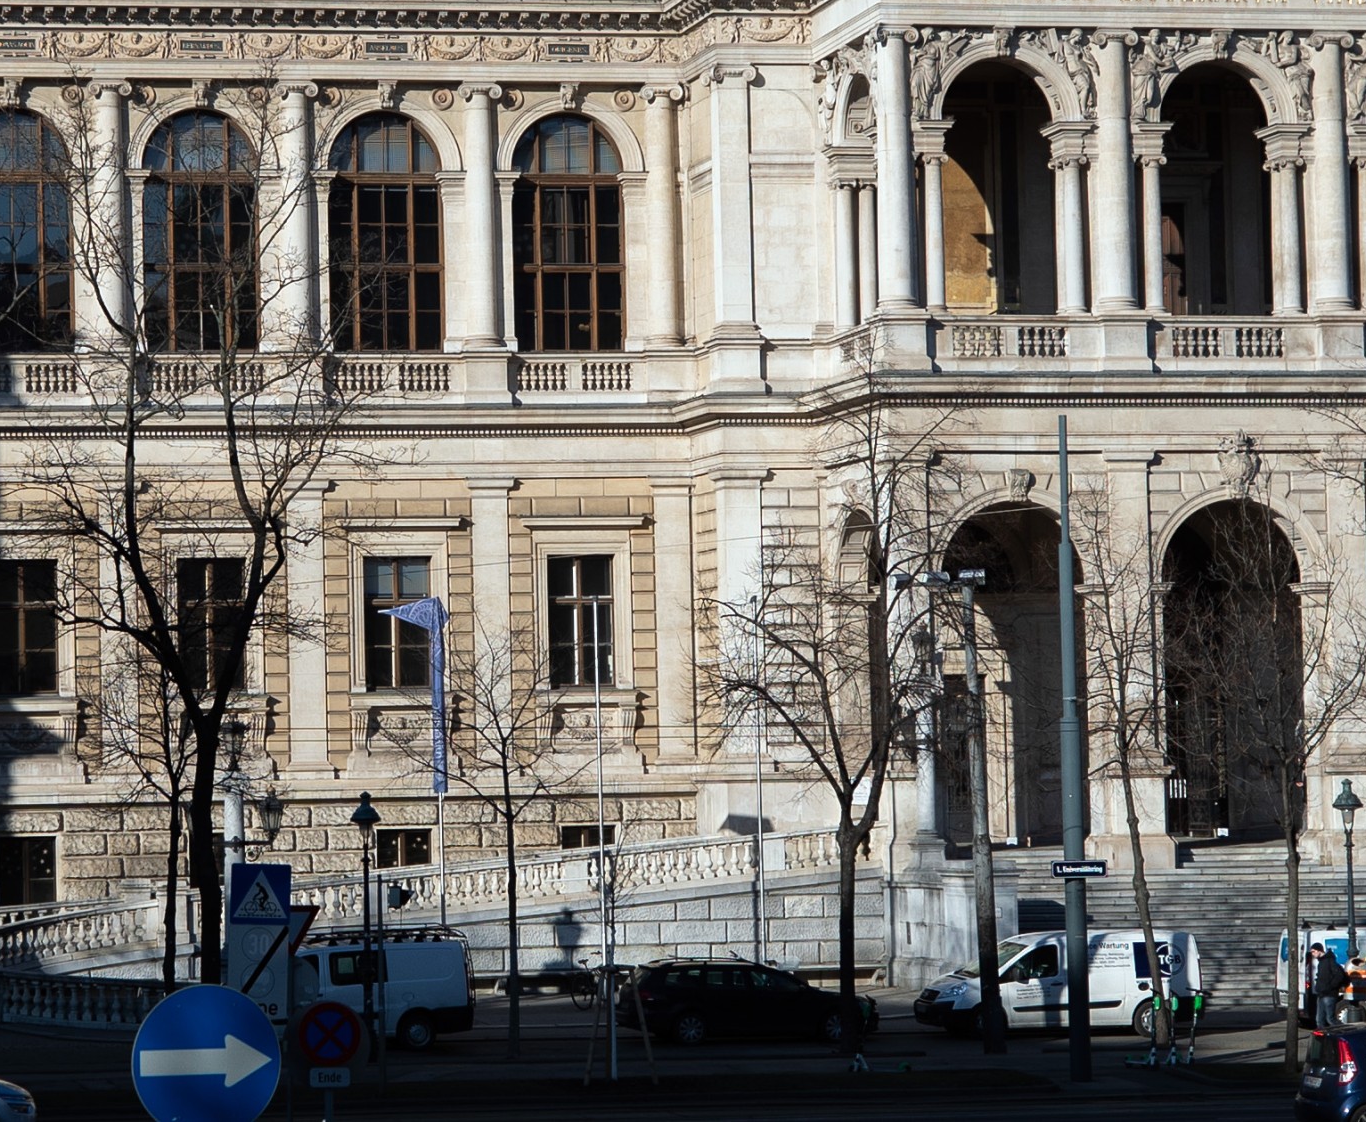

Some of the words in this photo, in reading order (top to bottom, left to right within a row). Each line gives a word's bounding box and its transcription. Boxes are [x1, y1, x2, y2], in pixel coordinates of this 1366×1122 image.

[1099, 942, 1129, 950] Wartung
[1158, 954, 1181, 966] TGB
[318, 1072, 342, 1083] Ende
